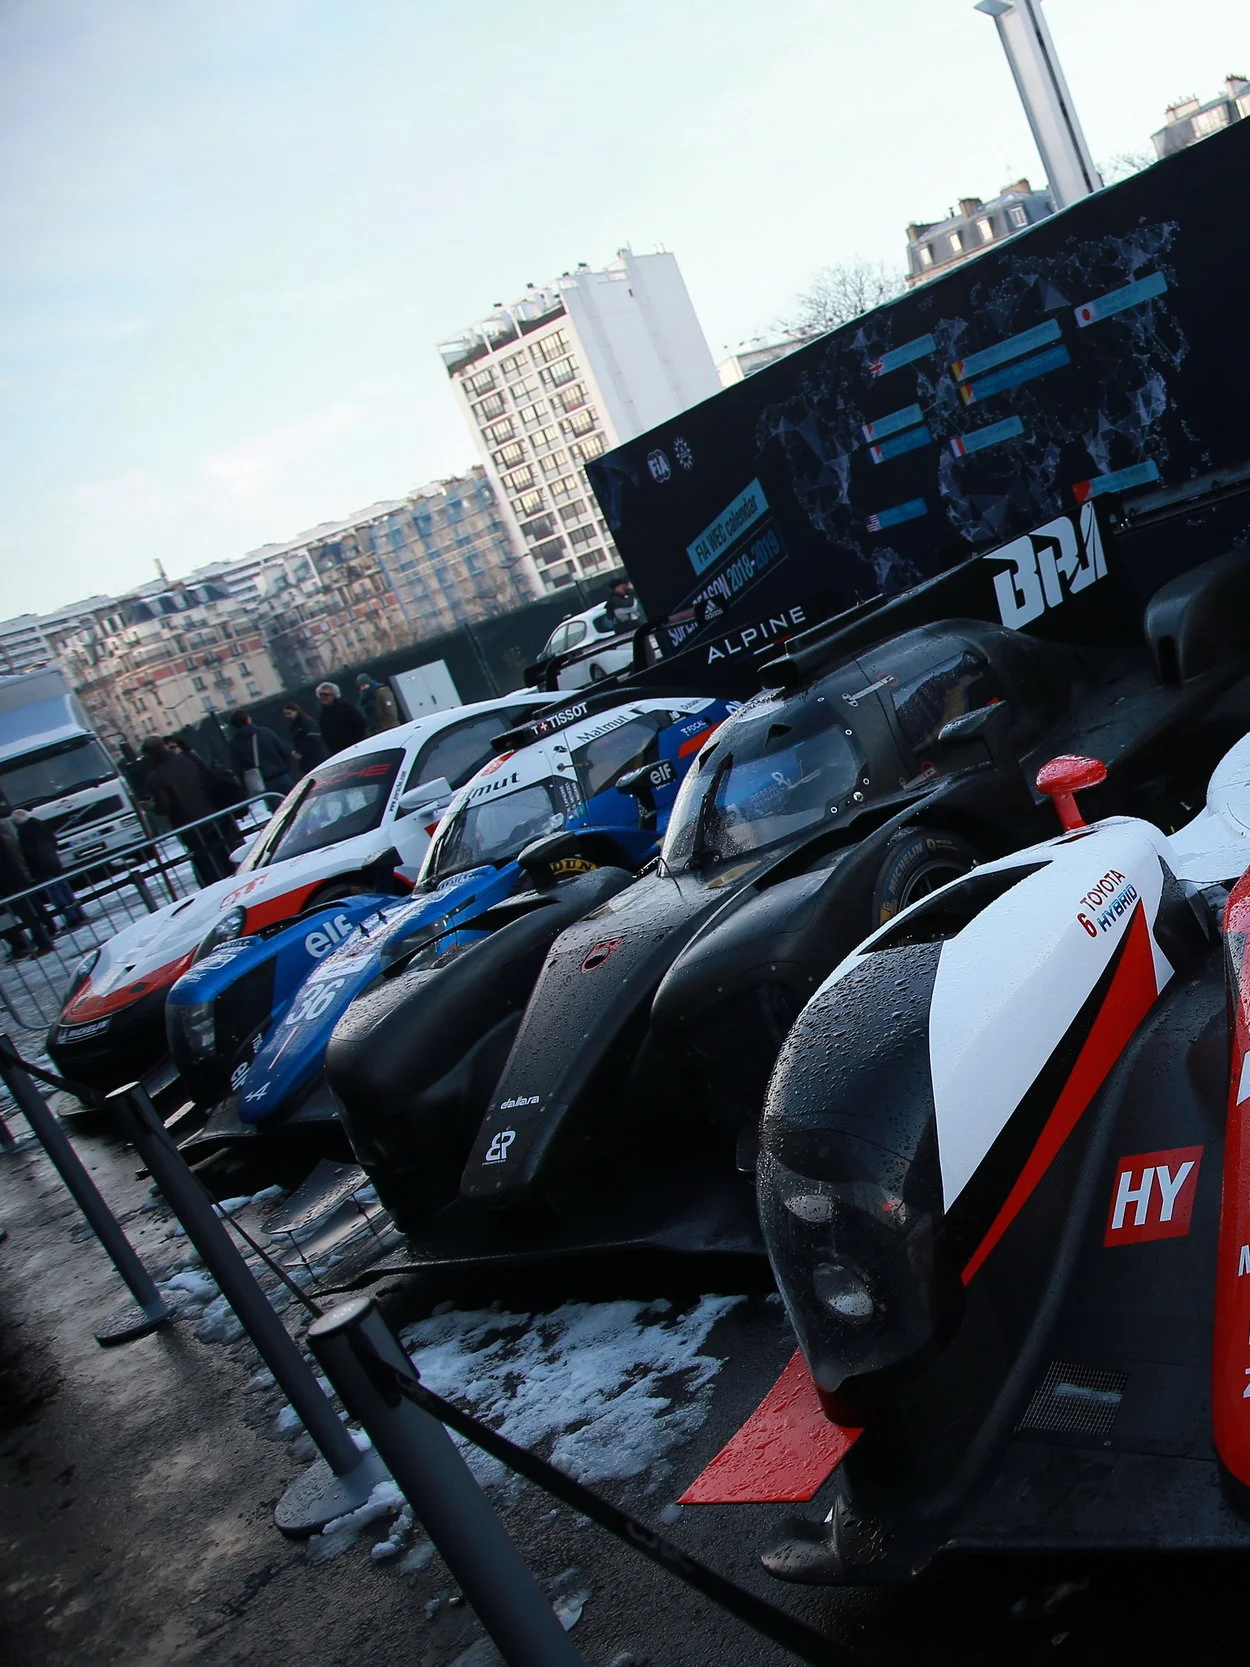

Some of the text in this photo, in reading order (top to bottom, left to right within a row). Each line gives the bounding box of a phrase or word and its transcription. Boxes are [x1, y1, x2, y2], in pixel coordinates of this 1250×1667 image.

[695, 494, 759, 565] FIA WEC calendar
[707, 606, 806, 664] ALPINE
[547, 702, 589, 729] TISSOT
[650, 764, 673, 785] elf
[888, 842, 923, 895] MICHELIN
[1077, 869, 1126, 938] 6 TOYOTA
[1096, 883, 1138, 933] HYBRID
[305, 914, 354, 958] elf
[285, 978, 346, 1026] 36
[500, 1095, 540, 1110] dallara
[1109, 1160, 1195, 1230] HY
